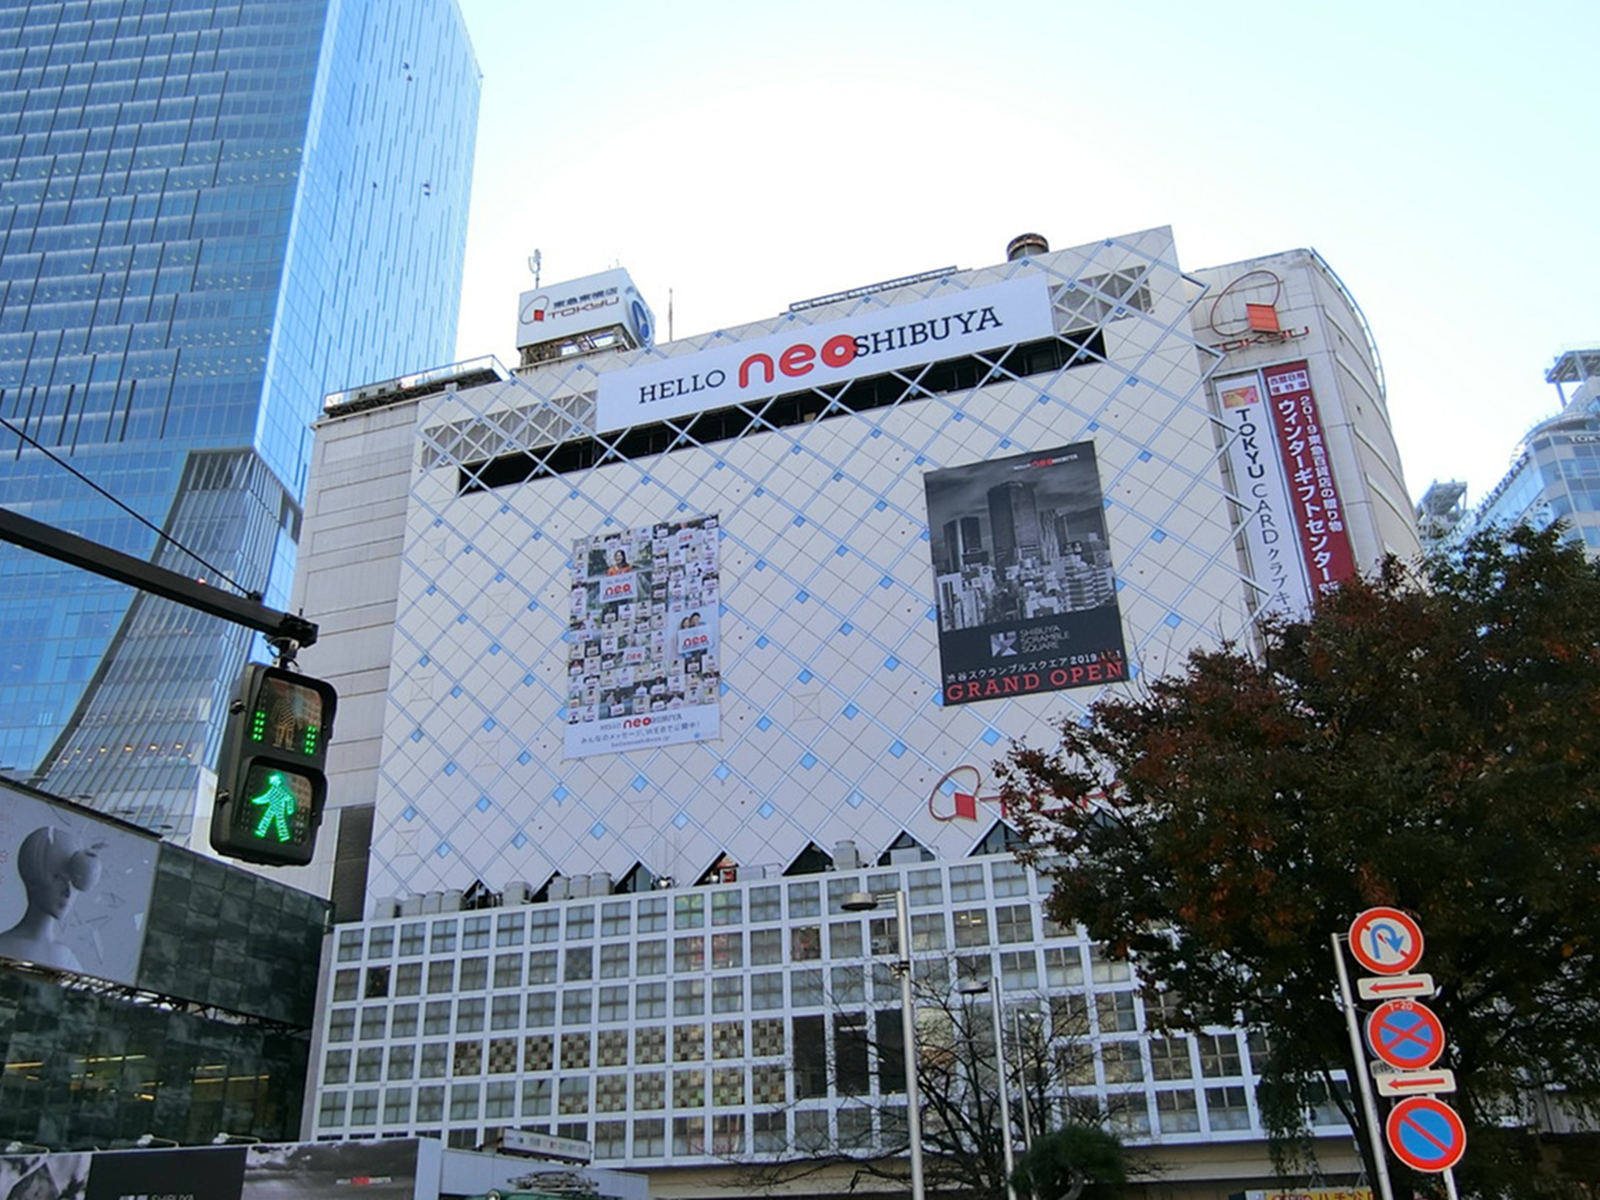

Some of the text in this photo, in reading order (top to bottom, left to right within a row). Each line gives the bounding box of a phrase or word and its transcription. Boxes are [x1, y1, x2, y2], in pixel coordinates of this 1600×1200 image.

[547, 297, 620, 319] TOKYU
[639, 305, 1004, 404] HELLO neo SHIBUYA
[1235, 407, 1265, 479] TOKYU
[1252, 483, 1279, 545] CARD
[1278, 399, 1331, 581] ウィンターギフトセンター
[946, 661, 1124, 700] GRAND OPEN
[623, 716, 651, 730] neo
